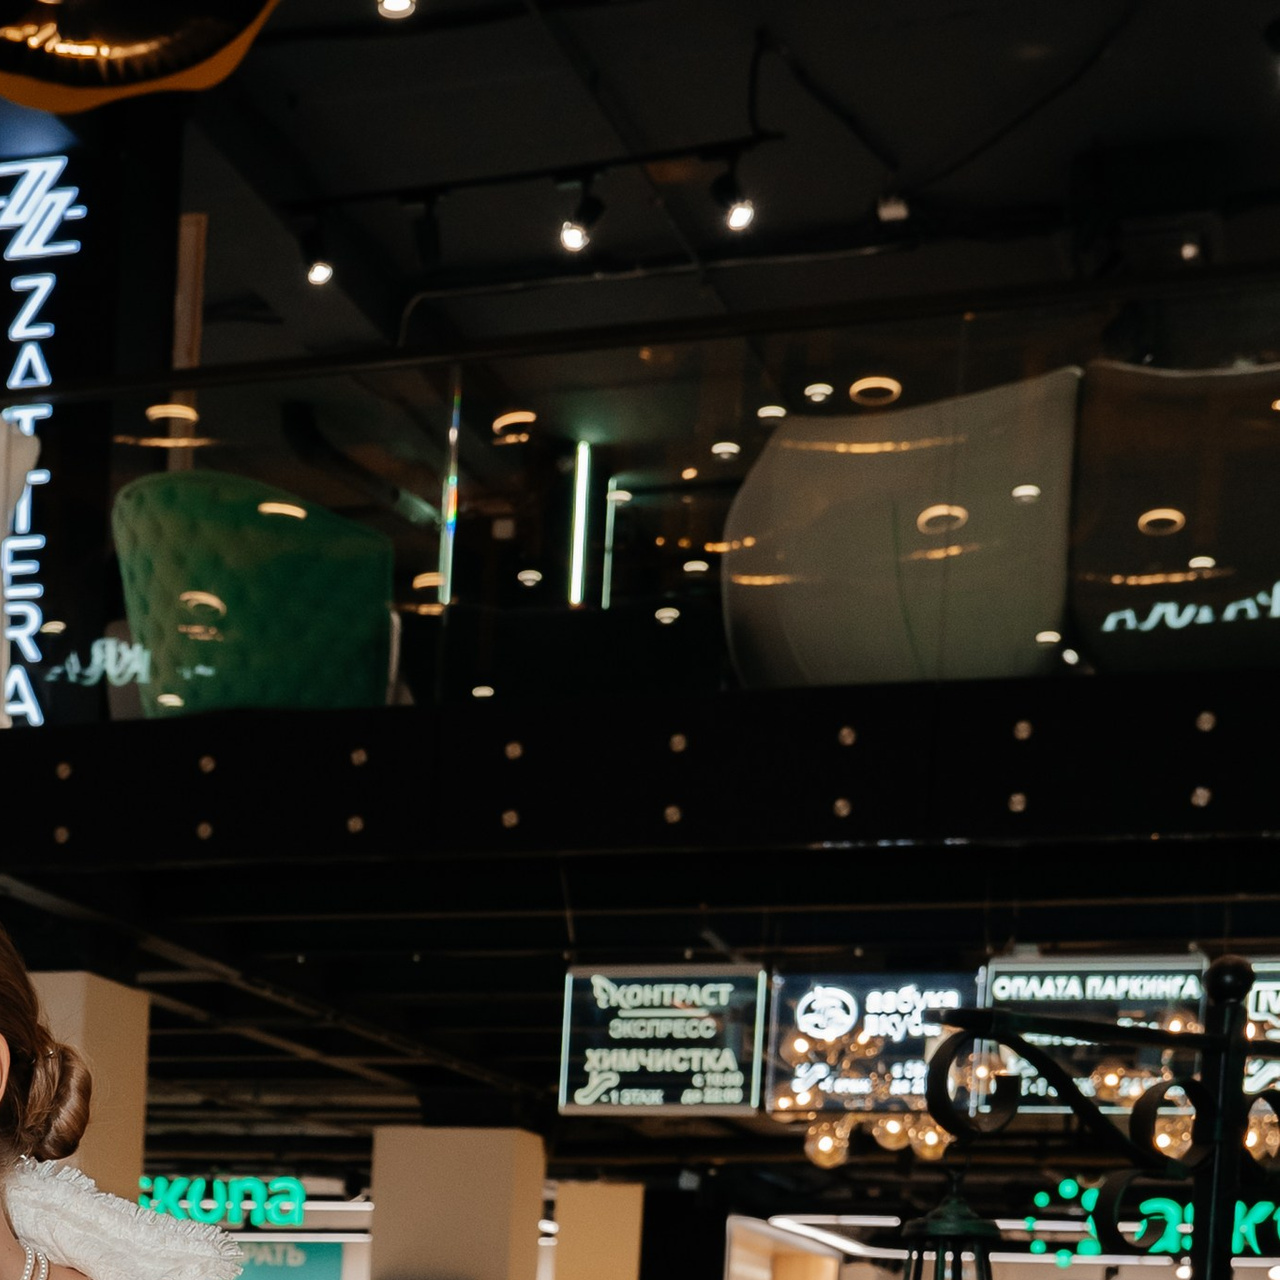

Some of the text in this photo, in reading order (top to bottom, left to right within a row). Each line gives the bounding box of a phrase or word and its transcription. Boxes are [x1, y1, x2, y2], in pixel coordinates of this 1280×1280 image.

[610, 983, 735, 1009] КОНТРАСТ
[992, 974, 1203, 1001] ОПЛАТА ПАРКИНГА
[609, 1018, 718, 1039] ЭКСПРЕСС
[584, 1048, 738, 1073] ХИМЧИСТКА
